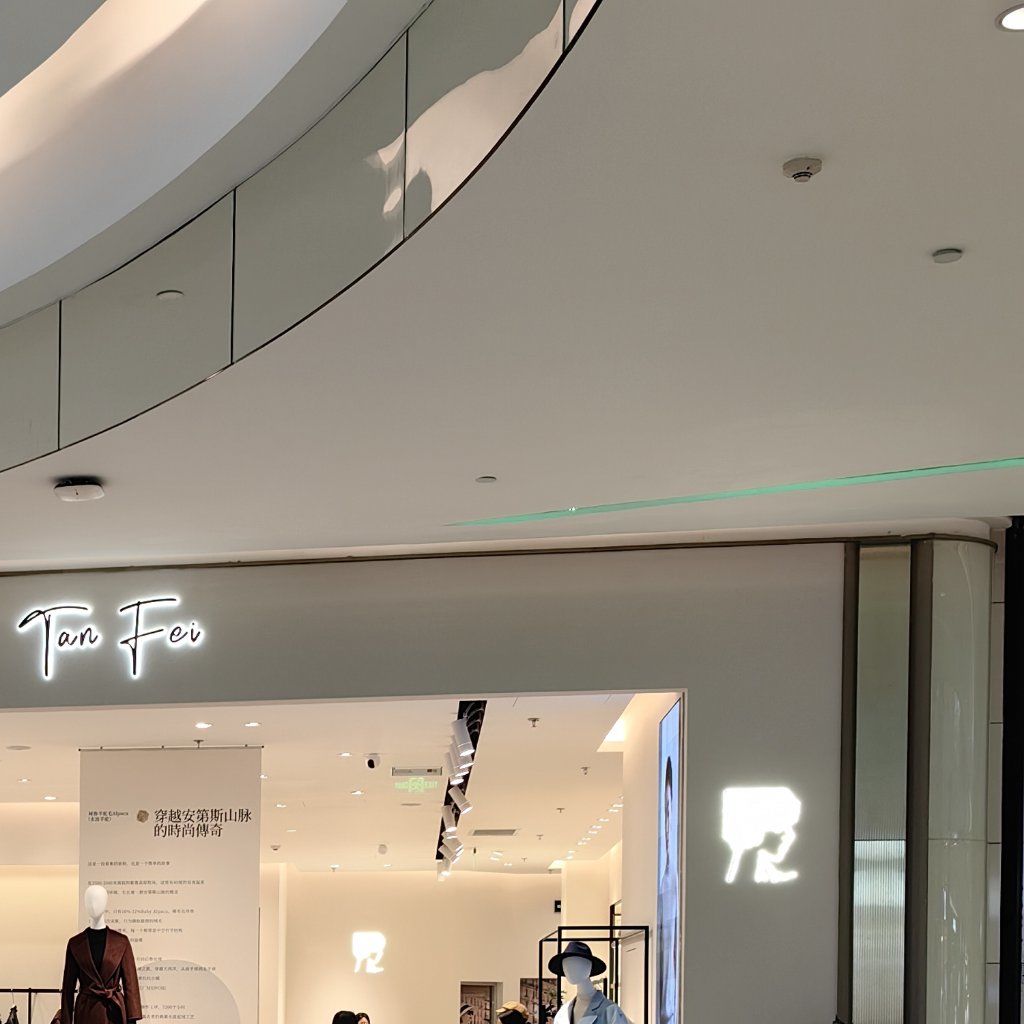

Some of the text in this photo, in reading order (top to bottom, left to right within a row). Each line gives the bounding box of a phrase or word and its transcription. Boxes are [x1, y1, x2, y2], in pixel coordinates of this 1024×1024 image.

[18, 598, 201, 678] Tan Fei
[154, 808, 252, 823] 穿越安第斯山脉
[153, 823, 223, 838] 的時尚傳奇
